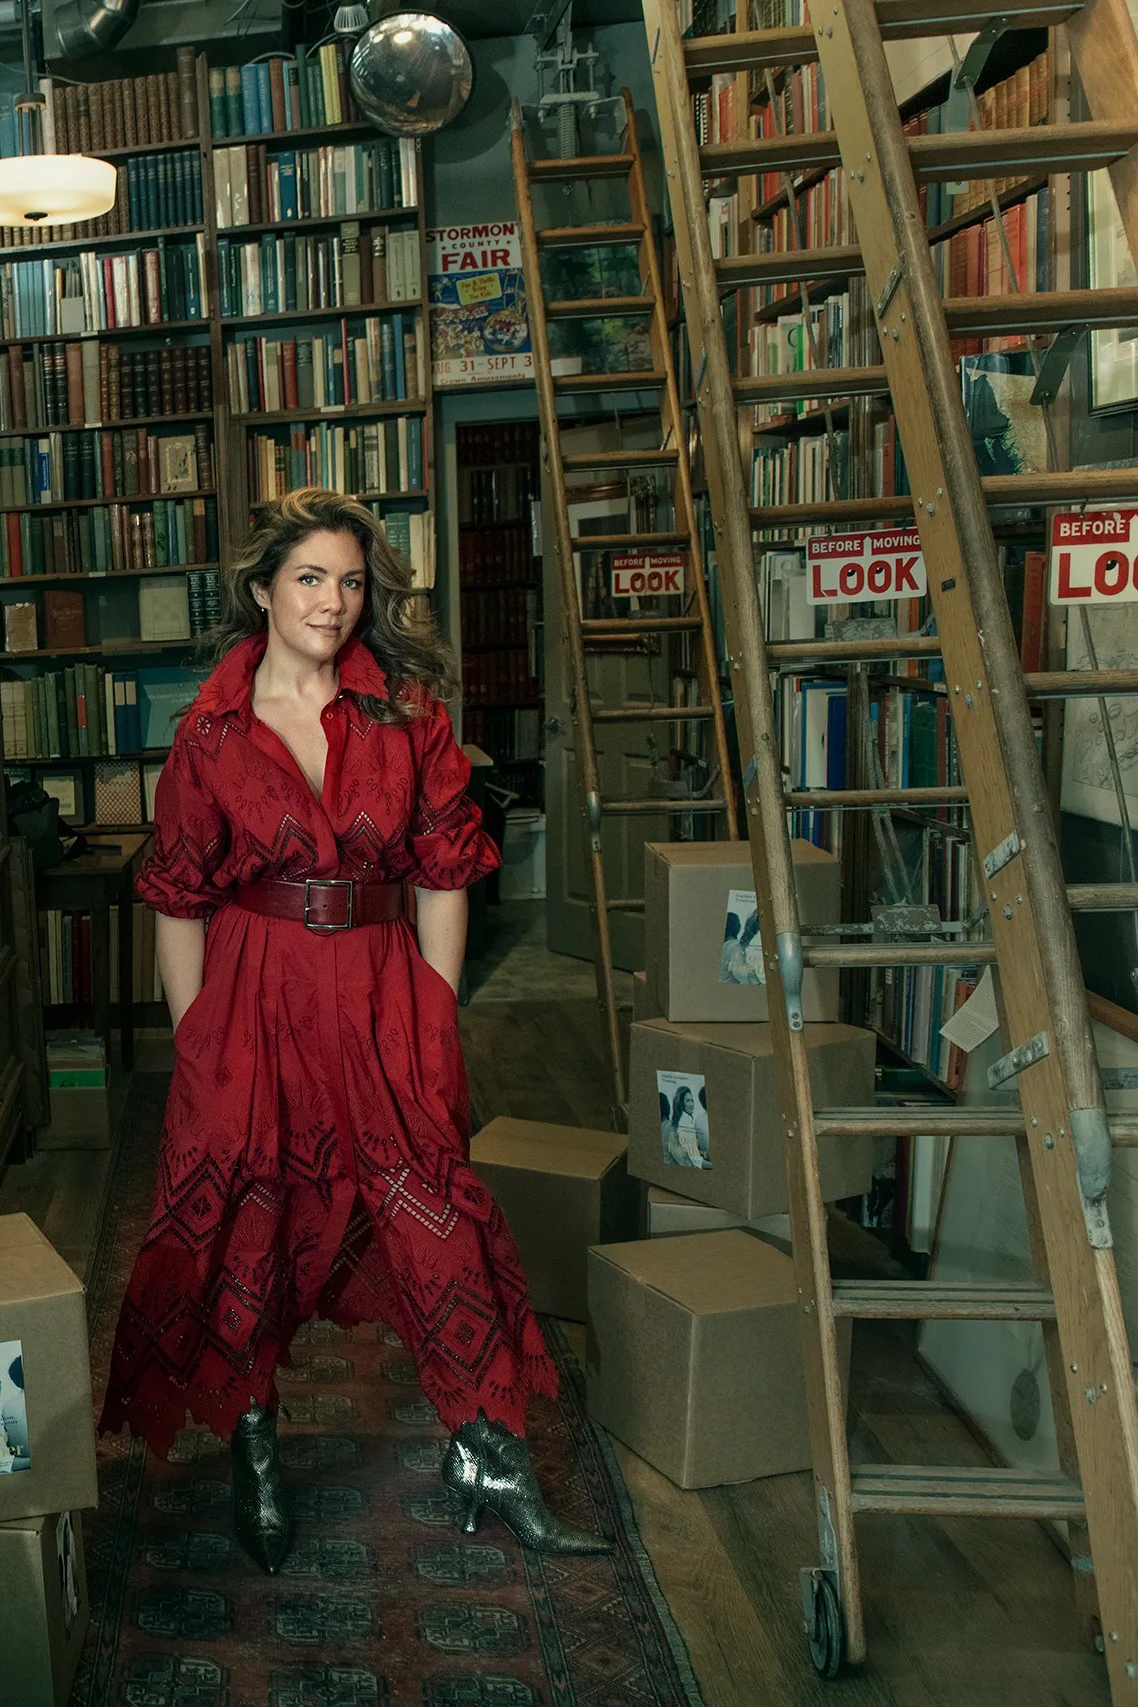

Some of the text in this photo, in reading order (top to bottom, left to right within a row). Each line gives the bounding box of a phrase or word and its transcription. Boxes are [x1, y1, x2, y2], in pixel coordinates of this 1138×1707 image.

[425, 223, 519, 243] STORMON
[451, 239, 500, 250] COUNTY
[441, 248, 511, 273] FAIR
[460, 360, 475, 372] 31
[487, 357, 516, 370] SEPT
[524, 355, 533, 367] 3
[1060, 520, 1126, 537] BEFORE
[812, 535, 920, 554] BEFORE MOVING
[614, 556, 681, 567] BEFORE MOVING
[614, 570, 681, 594] LOOK
[812, 556, 920, 598] LOOK
[1058, 550, 1138, 598] LO
